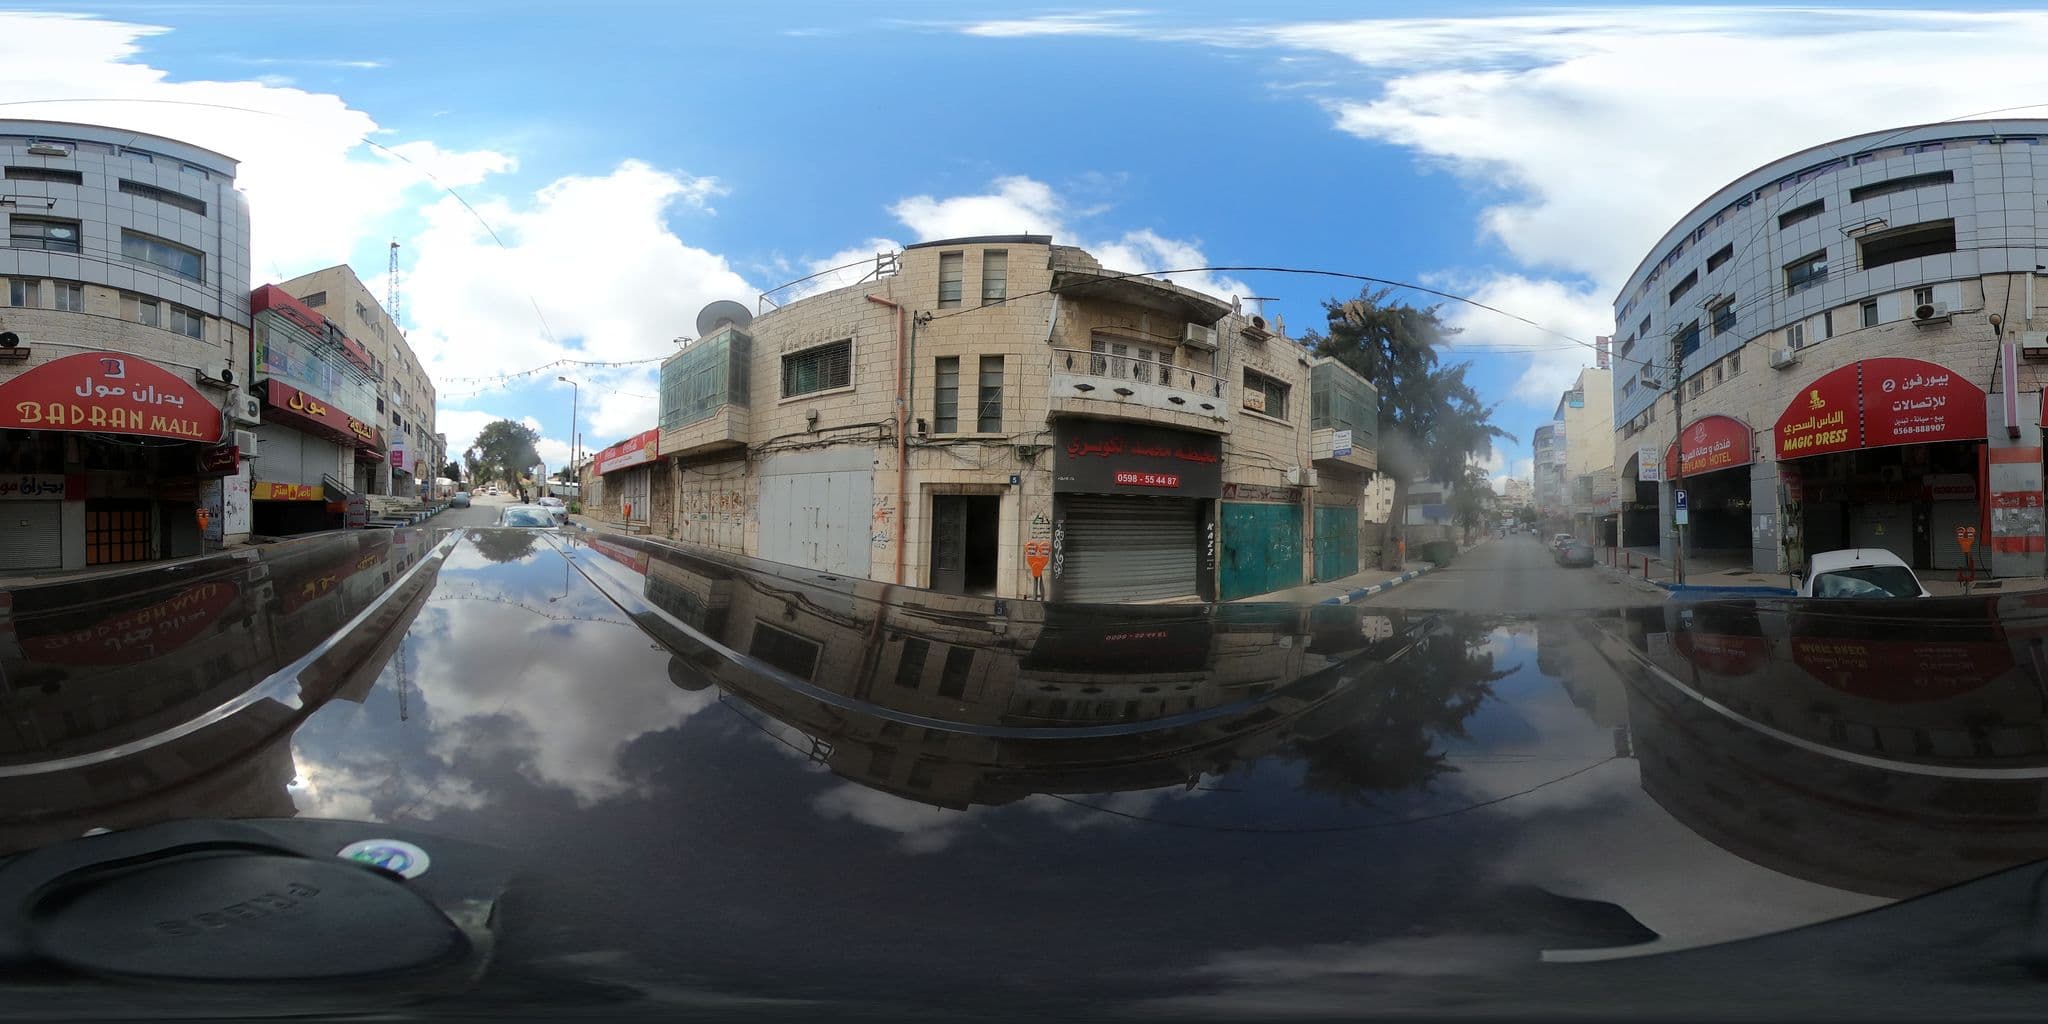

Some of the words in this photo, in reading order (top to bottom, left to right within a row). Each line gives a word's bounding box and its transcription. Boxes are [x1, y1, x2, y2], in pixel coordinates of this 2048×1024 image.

[75, 377, 126, 398] مول
[1902, 374, 1923, 390] فون
[1924, 373, 1949, 387] بيور
[132, 383, 184, 409] بدران
[289, 391, 327, 416] مول
[1892, 395, 1946, 412] للإتصالات
[16, 401, 144, 430] BADRAN
[150, 416, 203, 437] MALL
[1783, 416, 1815, 436] السحري
[1816, 409, 1844, 429] اللباس
[1893, 424, 1945, 435] 0568-888907
[1713, 438, 1731, 452] فندق
[1783, 434, 1813, 452] MAGIC
[1815, 428, 1848, 446] DRESS
[1681, 458, 1707, 473] ERYLAND
[1710, 452, 1731, 465] HOTEL
[1117, 474, 1139, 483] 0598
[1145, 475, 1154, 484] 55
[1155, 476, 1165, 485] 44
[1167, 477, 1177, 486] 87
[1677, 491, 1685, 503] P
